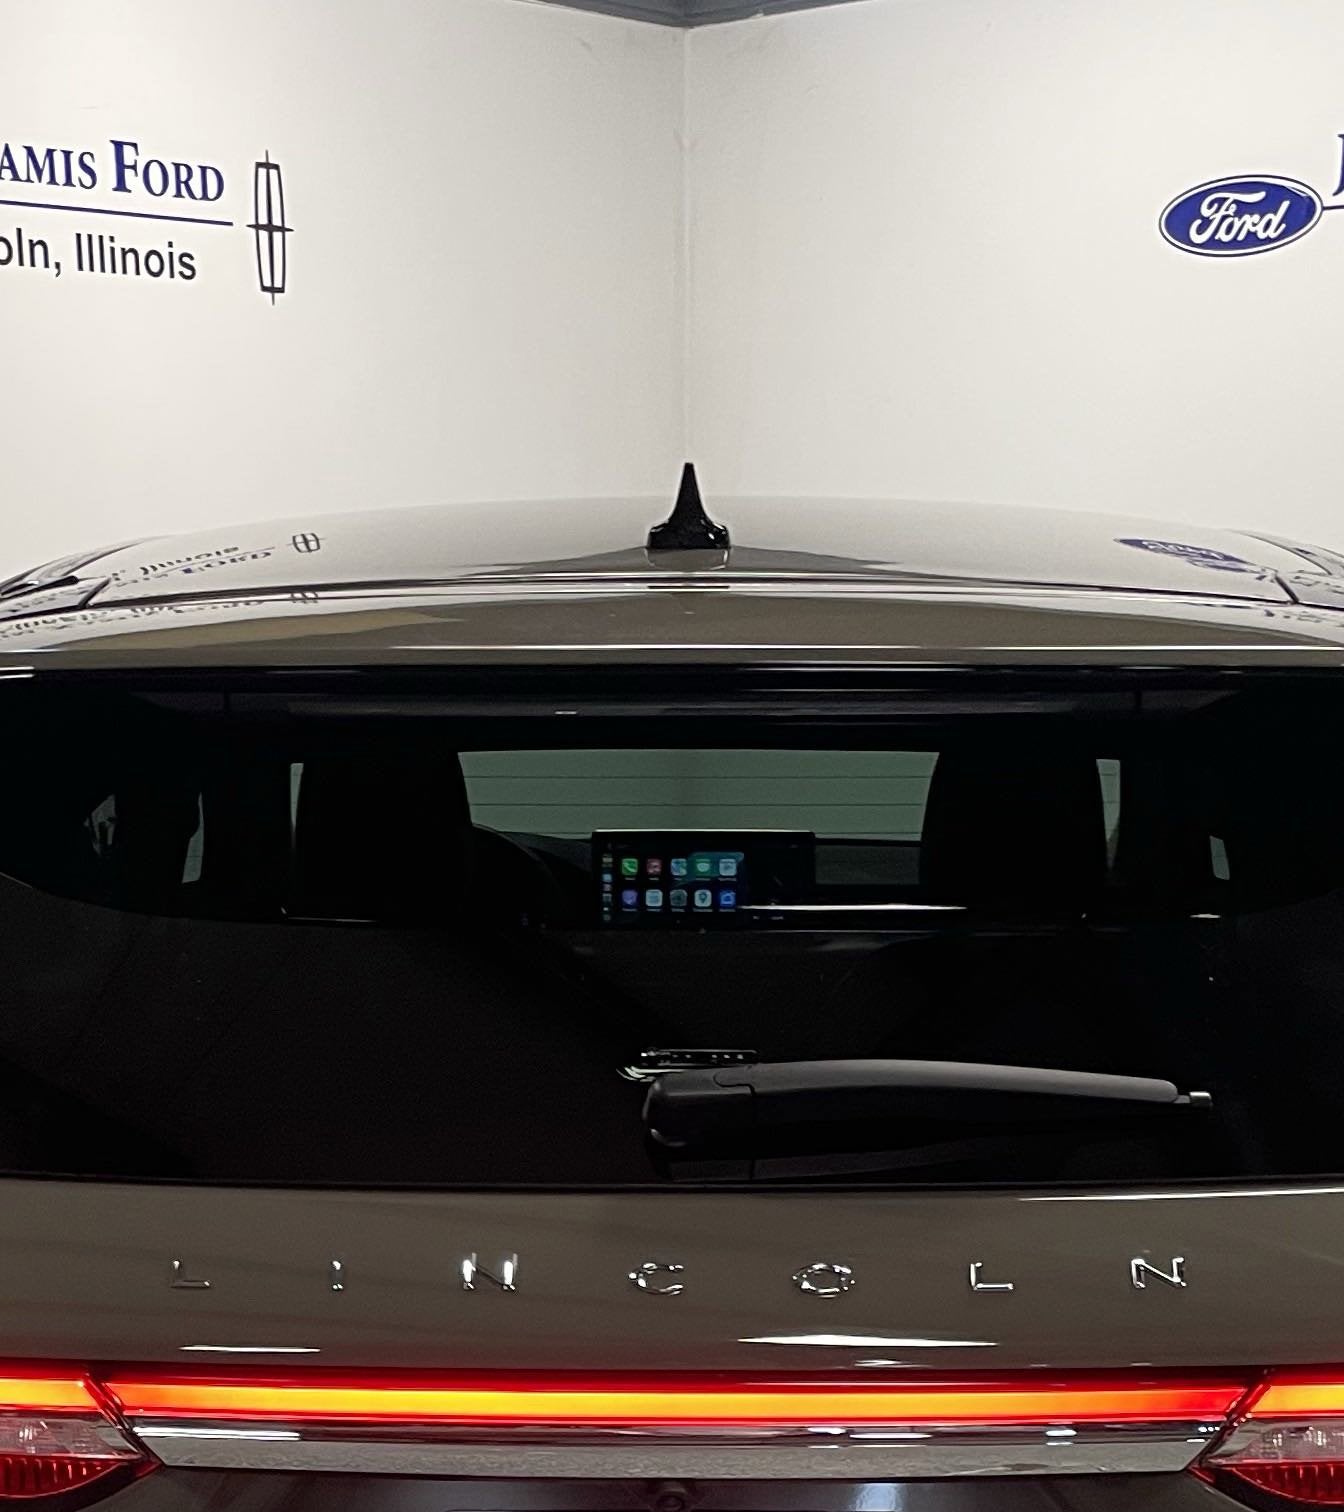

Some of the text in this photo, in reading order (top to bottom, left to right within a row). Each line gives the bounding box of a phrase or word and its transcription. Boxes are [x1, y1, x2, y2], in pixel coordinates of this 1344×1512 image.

[109, 139, 224, 202] FORD
[1189, 191, 1286, 244] Ford
[76, 233, 197, 281] Illinois
